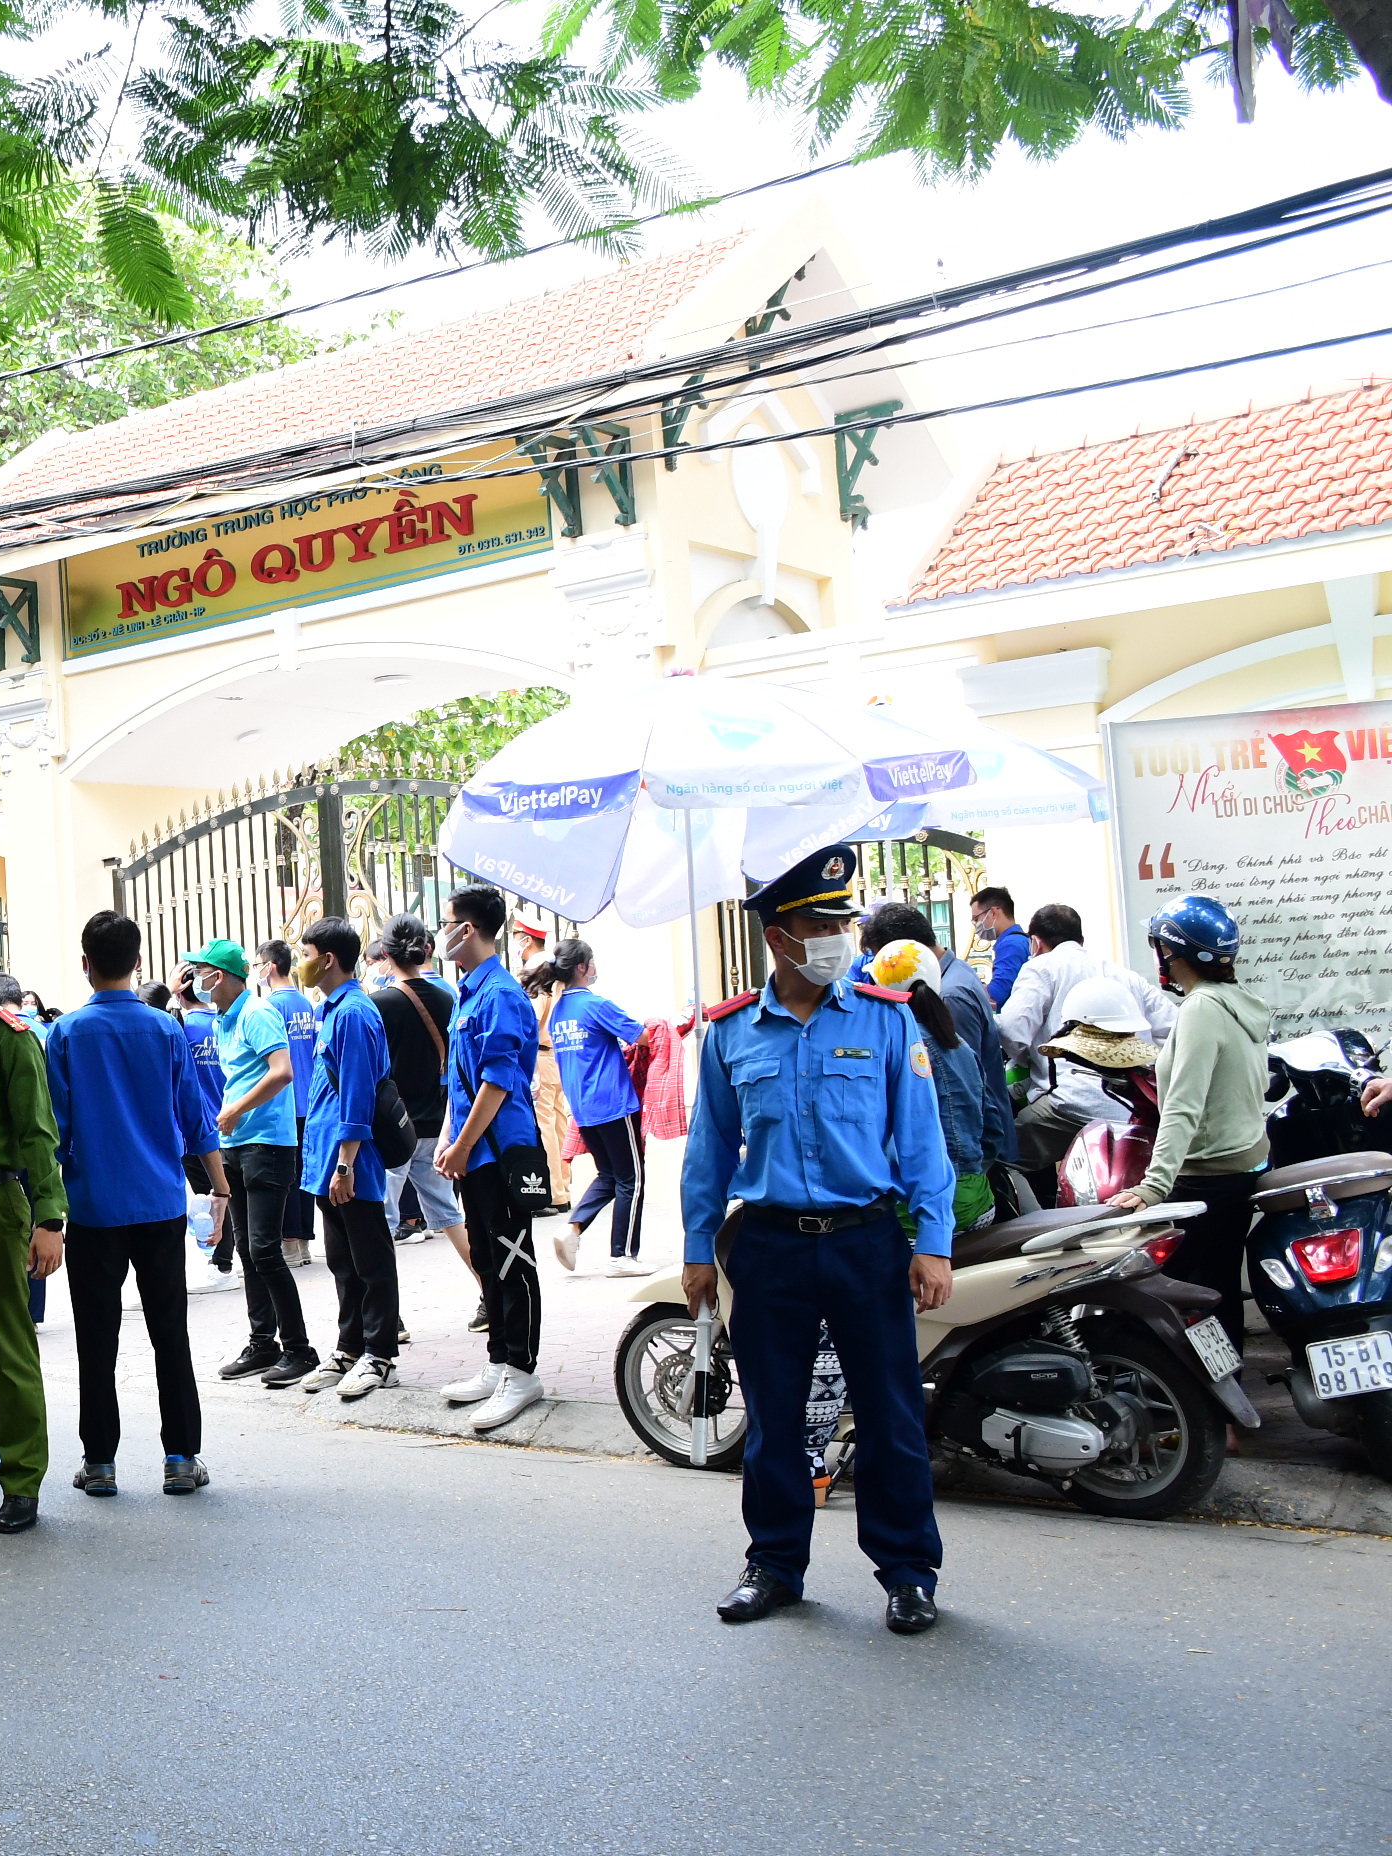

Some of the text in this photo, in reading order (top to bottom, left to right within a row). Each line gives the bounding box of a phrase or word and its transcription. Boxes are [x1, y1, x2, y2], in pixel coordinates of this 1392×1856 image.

[137, 527, 207, 558] TRƯỜNG
[211, 510, 273, 537] TRUNG
[280, 497, 321, 520] HỌC
[116, 490, 478, 619] NGÔ QUYỀN
[126, 619, 145, 633] LINH
[1128, 730, 1268, 778] TUỔI TRẺ
[887, 762, 952, 788] ViettelPay
[498, 785, 603, 813] ViettelPay
[666, 779, 843, 797] Ngân hàng số của người Việt
[951, 802, 1077, 822] Ngân hàng số của người Việt
[1243, 797, 1259, 817] DI
[1262, 790, 1306, 815] CHÚC
[1357, 801, 1392, 825] CHÂ
[1292, 793, 1367, 839] Theo
[1236, 854, 1274, 869] Chính
[1278, 853, 1303, 869] phủ
[1309, 853, 1324, 863] và
[1331, 847, 1362, 862] Bác
[1368, 846, 1389, 858] rất
[1191, 877, 1221, 891] Bác
[1224, 878, 1244, 889] vui
[1248, 876, 1276, 891] lòng
[1279, 871, 1309, 884] khen
[1313, 871, 1340, 886] ngợi
[1345, 867, 1385, 883] những
[1247, 896, 1274, 907] niên
[1276, 893, 1306, 908] phải
[1344, 888, 1383, 904] phong
[1288, 913, 1308, 923] nơi
[1313, 909, 1336, 920] nào
[1340, 907, 1375, 923] người
[1159, 923, 1187, 946] Vespa
[1239, 925, 1387, 947] hải xung phong đến làm
[1254, 952, 1283, 967] phải
[1289, 949, 1317, 962] luôn
[1323, 947, 1351, 959] luôn
[1356, 947, 1378, 957] rèn
[1345, 964, 1372, 977] cách
[1270, 1007, 1305, 1025] Trung
[1354, 1001, 1387, 1016] Trọn
[554, 1019, 578, 1035] CLB
[520, 1185, 547, 1195] adidas
[1321, 1338, 1383, 1369] 15-B1
